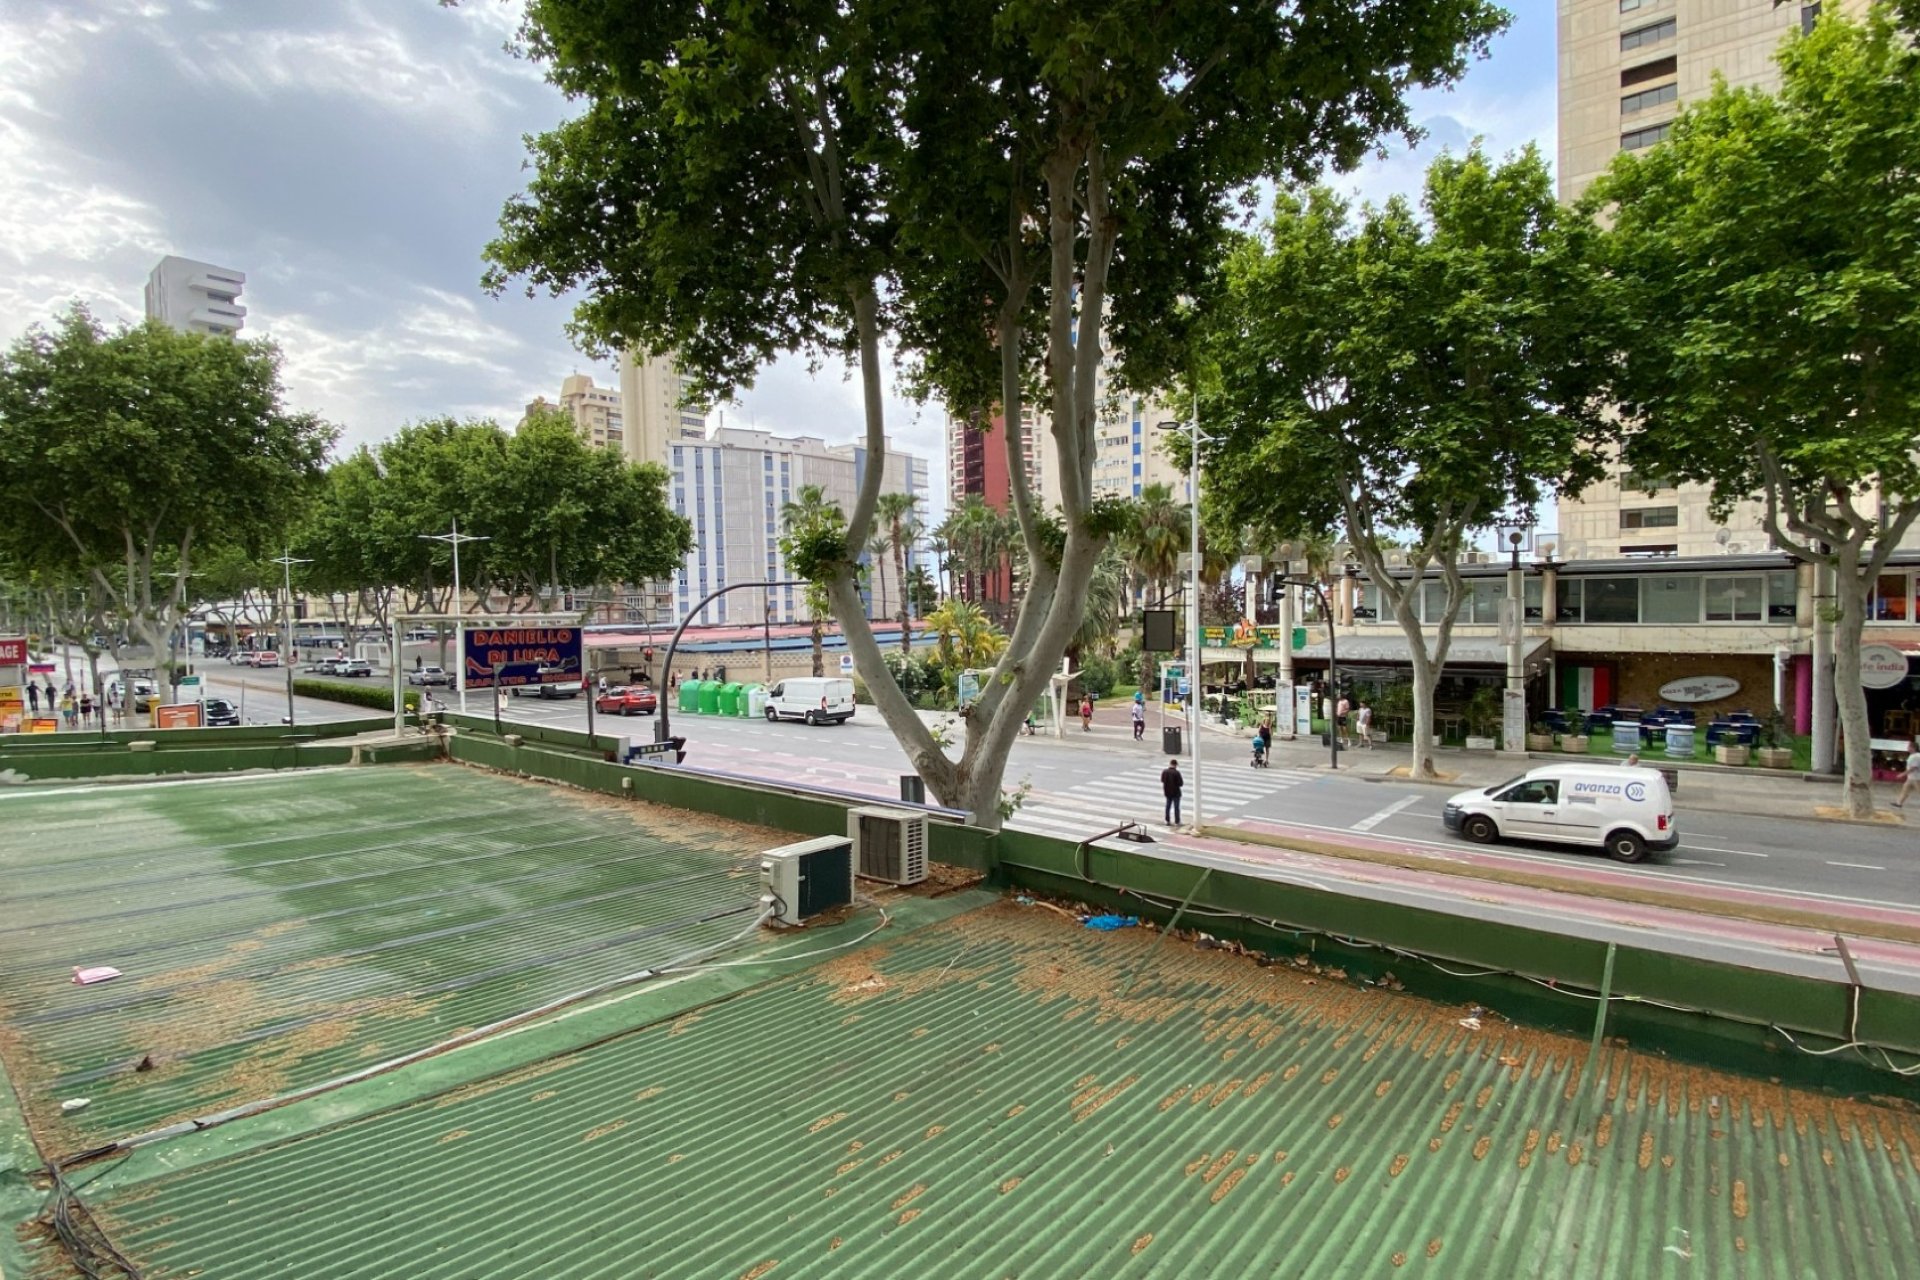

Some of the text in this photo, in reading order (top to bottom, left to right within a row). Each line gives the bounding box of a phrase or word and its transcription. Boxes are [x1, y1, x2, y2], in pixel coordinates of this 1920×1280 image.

[473, 629, 572, 646] DANIELLO
[487, 648, 560, 665] DI LUCA
[1574, 782, 1621, 794] avanza
